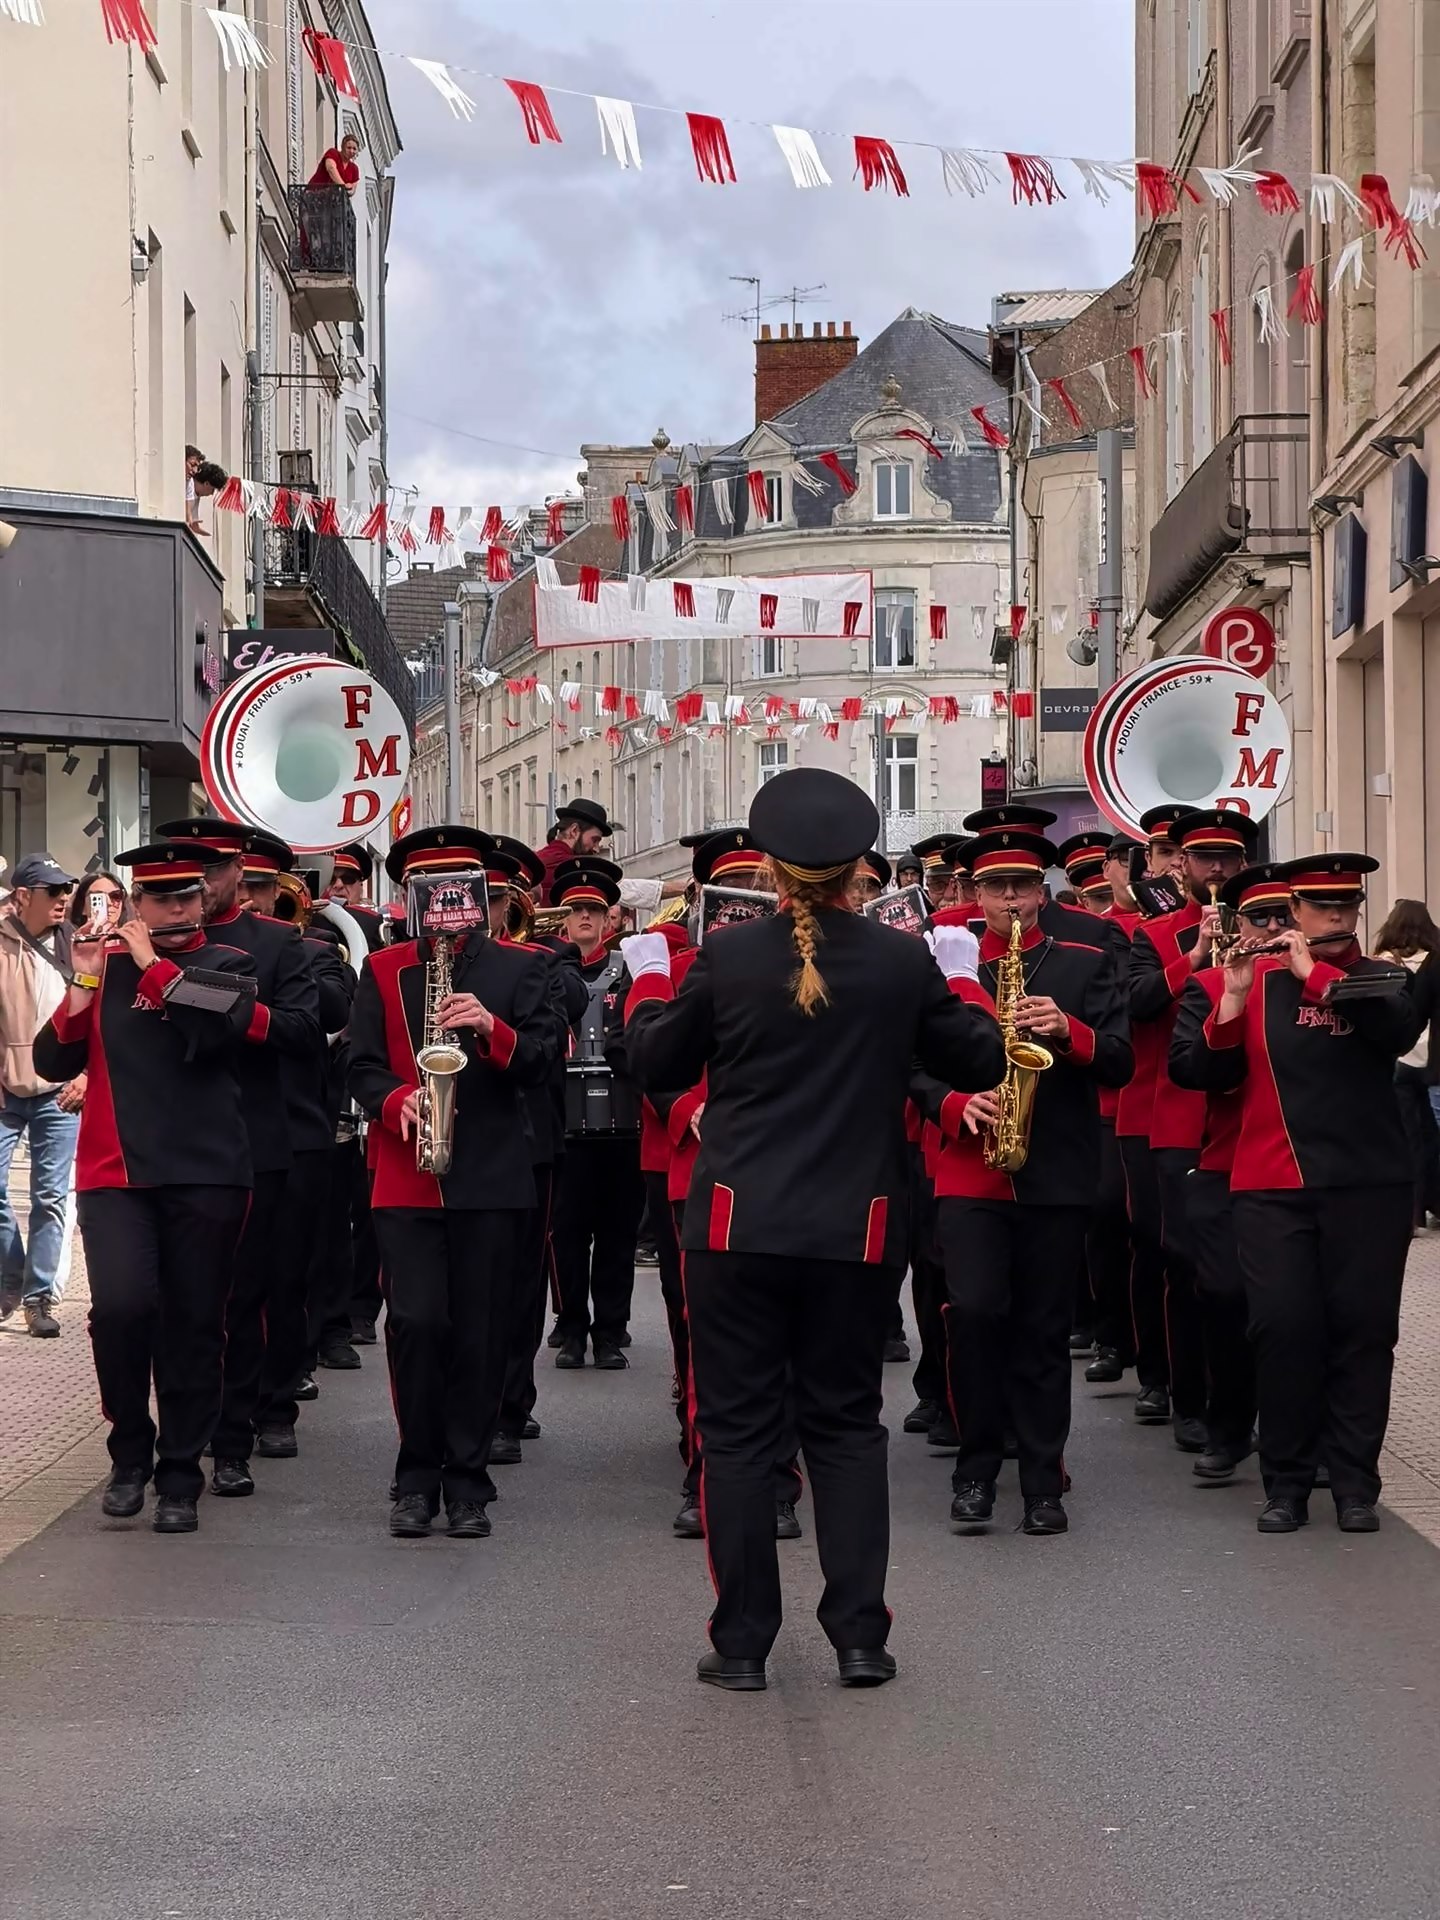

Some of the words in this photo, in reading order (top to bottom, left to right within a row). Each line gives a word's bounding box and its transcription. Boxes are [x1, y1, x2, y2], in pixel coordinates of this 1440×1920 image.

[233, 641, 329, 669] Et
[235, 722, 250, 758] DOUAI
[248, 682, 284, 718] FRANCE
[289, 672, 303, 685] 59
[1118, 711, 1140, 746] DOUAI
[1141, 678, 1182, 708] FRANCE
[1189, 674, 1203, 685] 59
[338, 685, 401, 827] FMD
[1296, 1006, 1355, 1036] FMD
